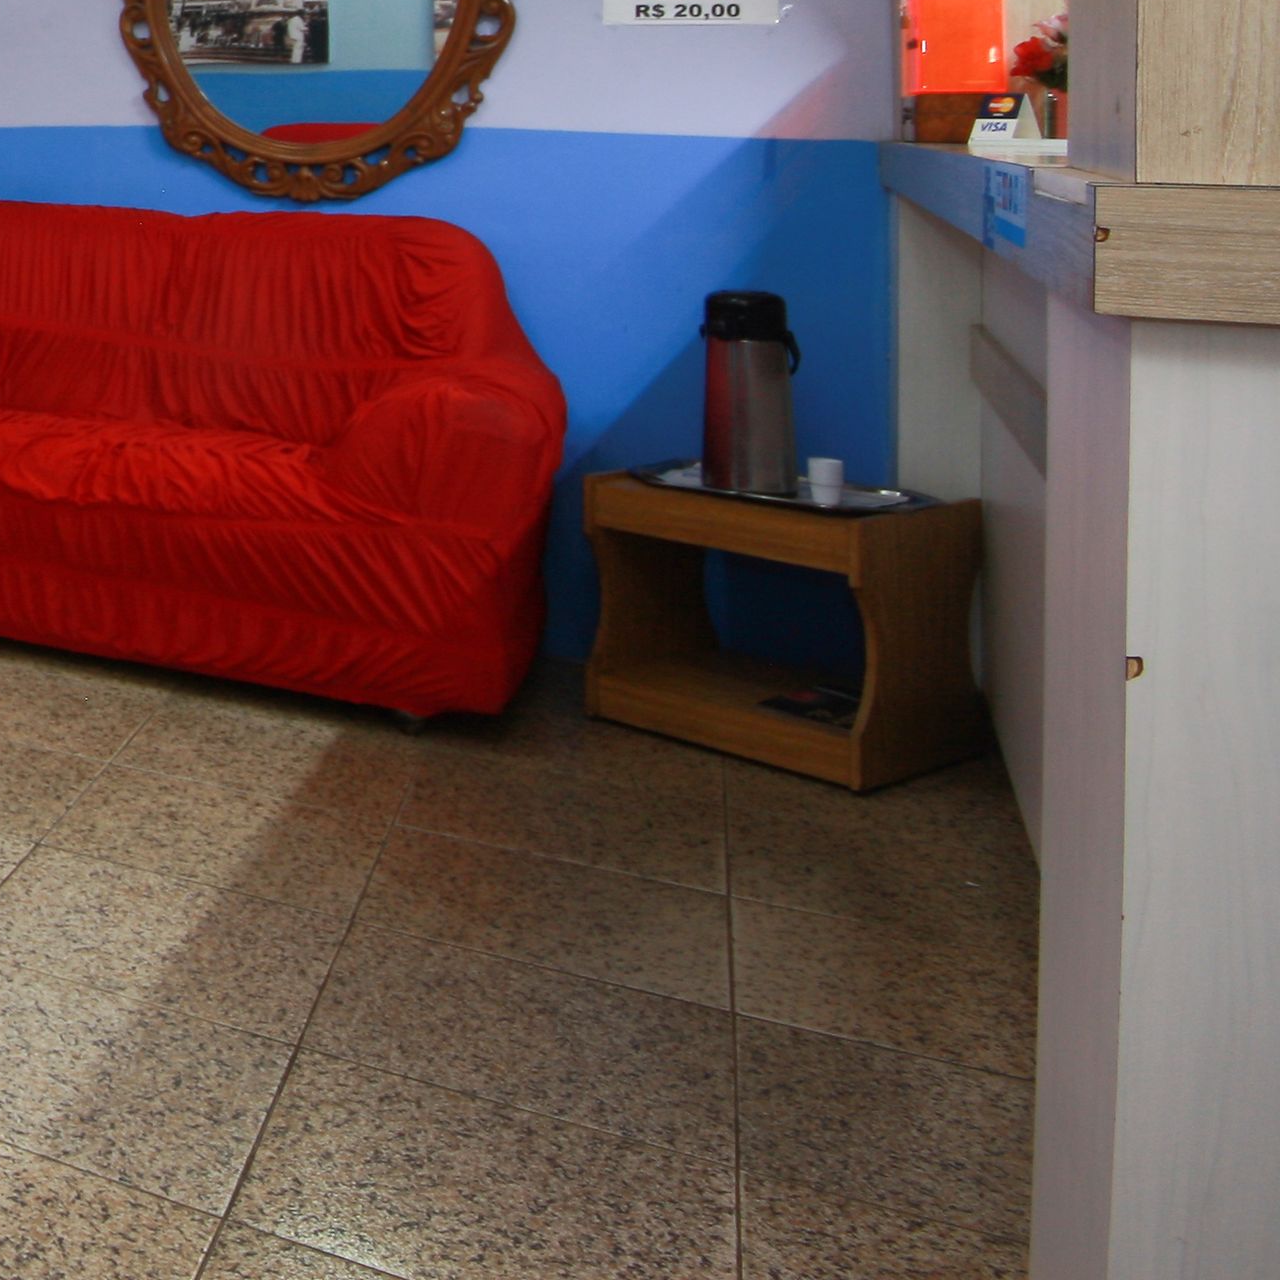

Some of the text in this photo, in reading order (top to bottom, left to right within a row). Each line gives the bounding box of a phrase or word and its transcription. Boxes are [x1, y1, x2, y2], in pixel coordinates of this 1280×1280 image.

[635, 3, 741, 20] R$ 20,00
[981, 122, 1007, 132] VISA
